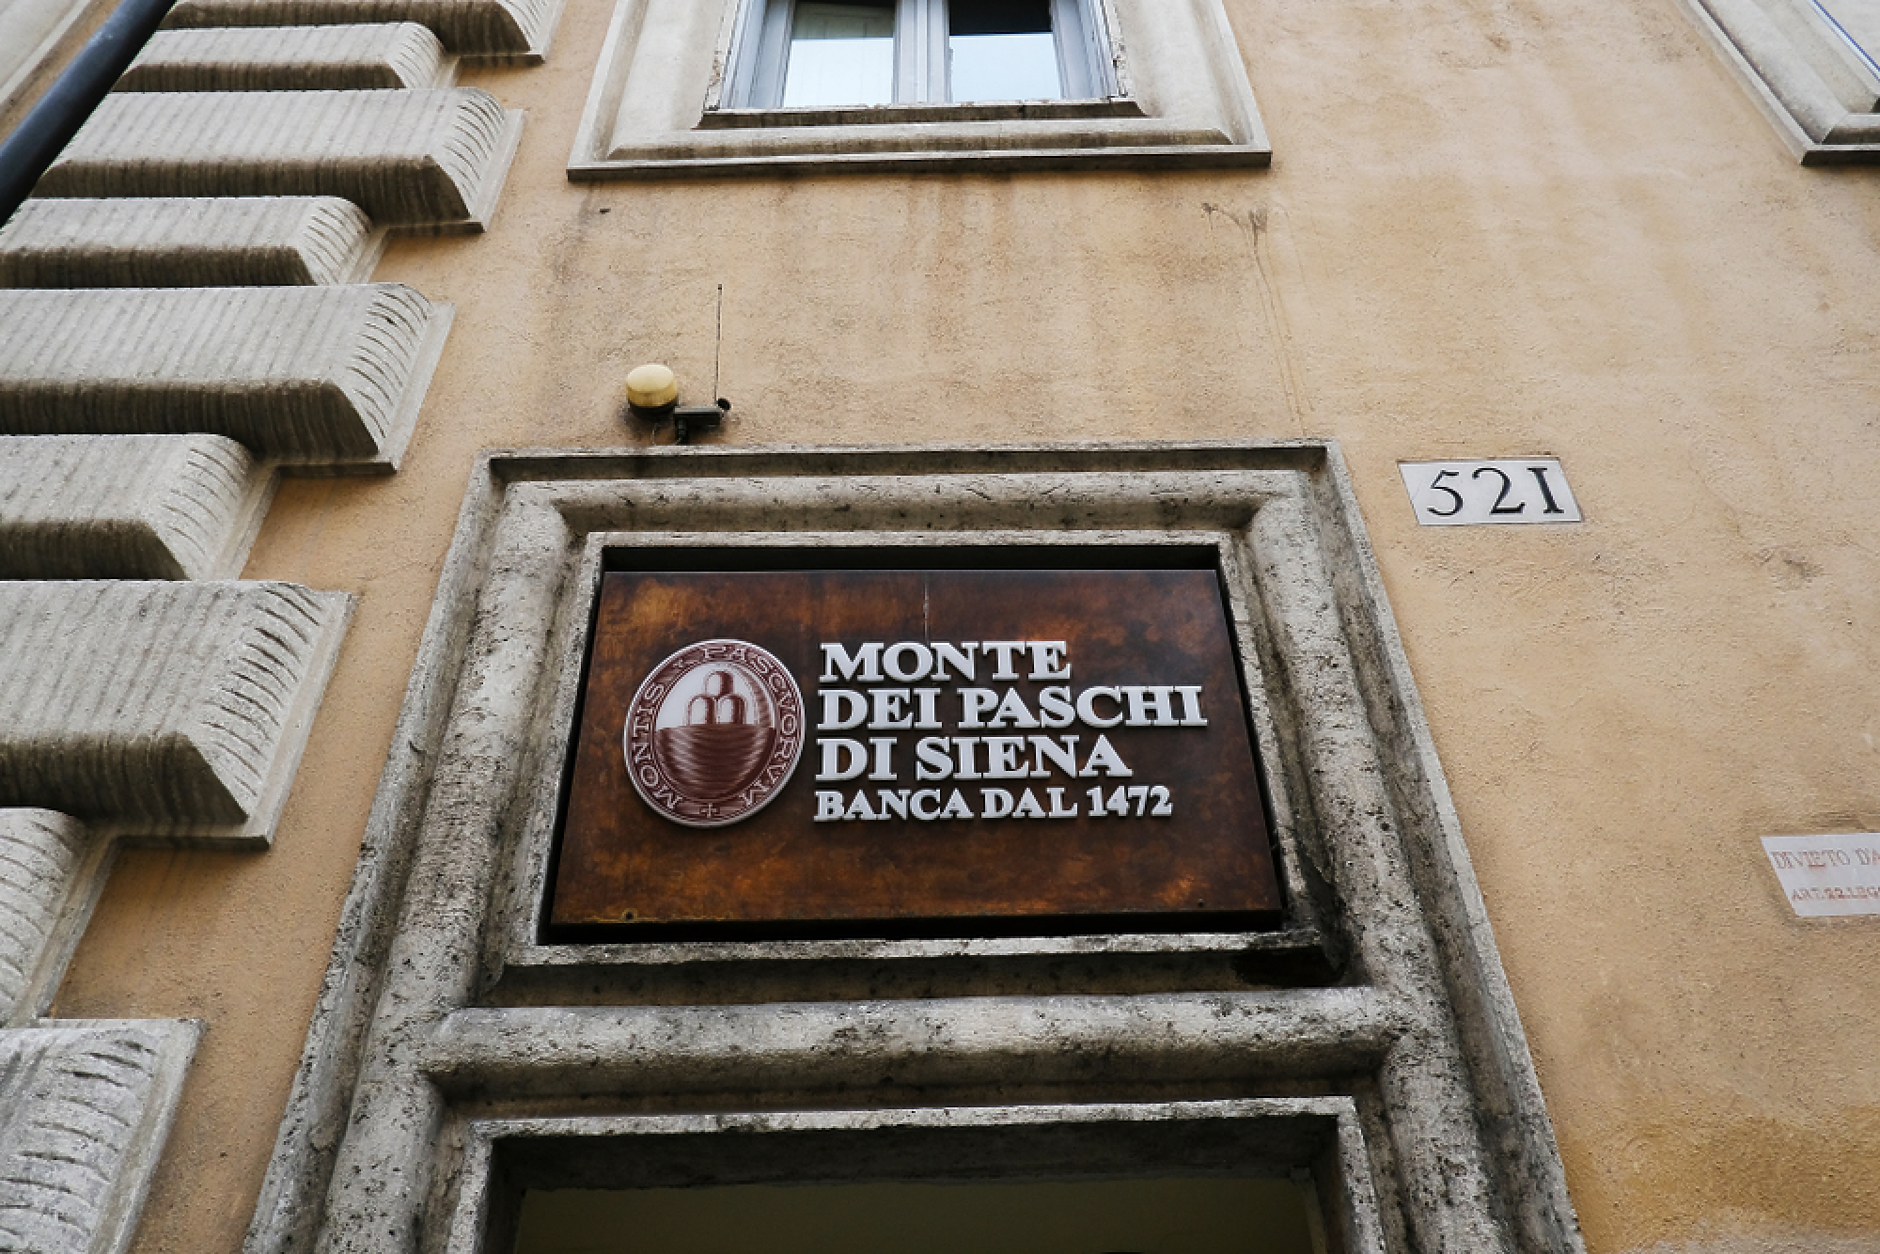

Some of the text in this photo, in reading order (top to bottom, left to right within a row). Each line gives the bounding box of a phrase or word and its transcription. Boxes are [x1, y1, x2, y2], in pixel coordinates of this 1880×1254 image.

[819, 640, 1072, 682] MONTE
[817, 685, 1208, 730] DEI PASCHI
[632, 682, 683, 810] MONTIS
[815, 734, 1133, 781] DI SIENA
[813, 785, 1173, 822] BANCA DAL 1472
[1770, 849, 1851, 869] DIVIETO
